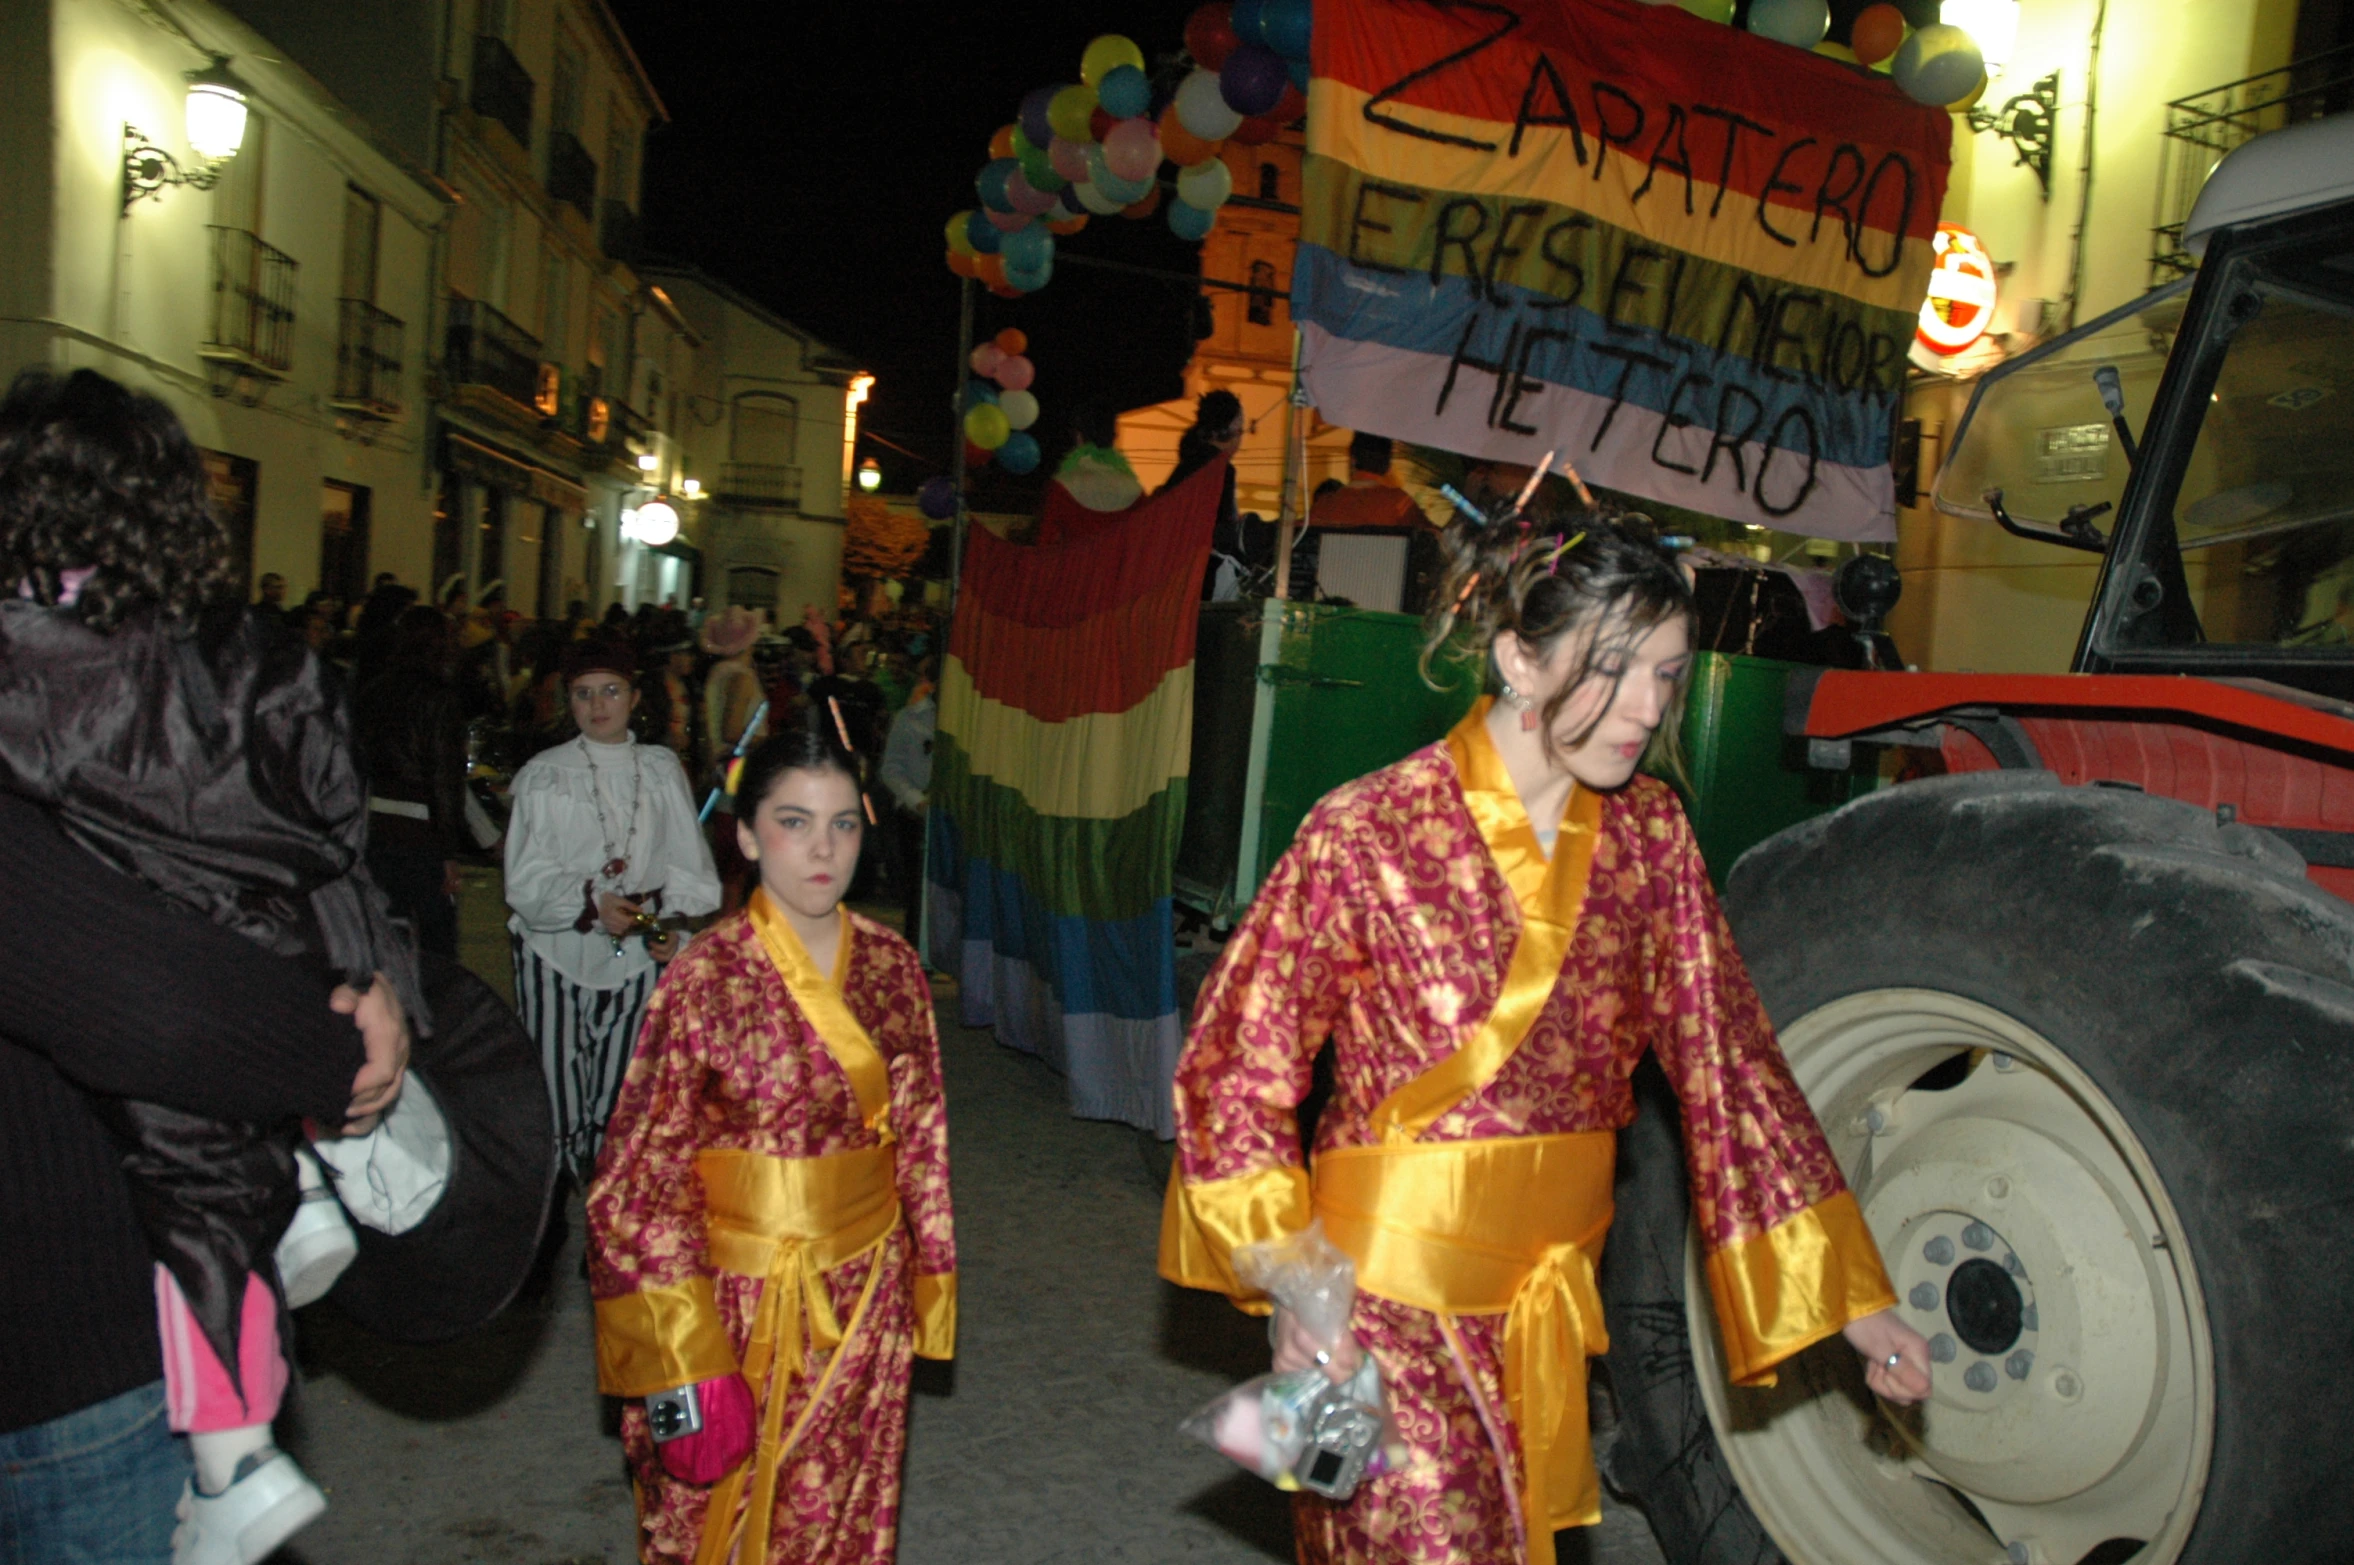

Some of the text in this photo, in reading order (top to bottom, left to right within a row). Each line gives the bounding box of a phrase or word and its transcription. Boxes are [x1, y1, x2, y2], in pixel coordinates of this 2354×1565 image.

[1363, 0, 1917, 278] ZAPATERO
[1349, 182, 1594, 311] ERES
[1604, 246, 1694, 356] EL
[1435, 313, 1819, 517] HETERO
